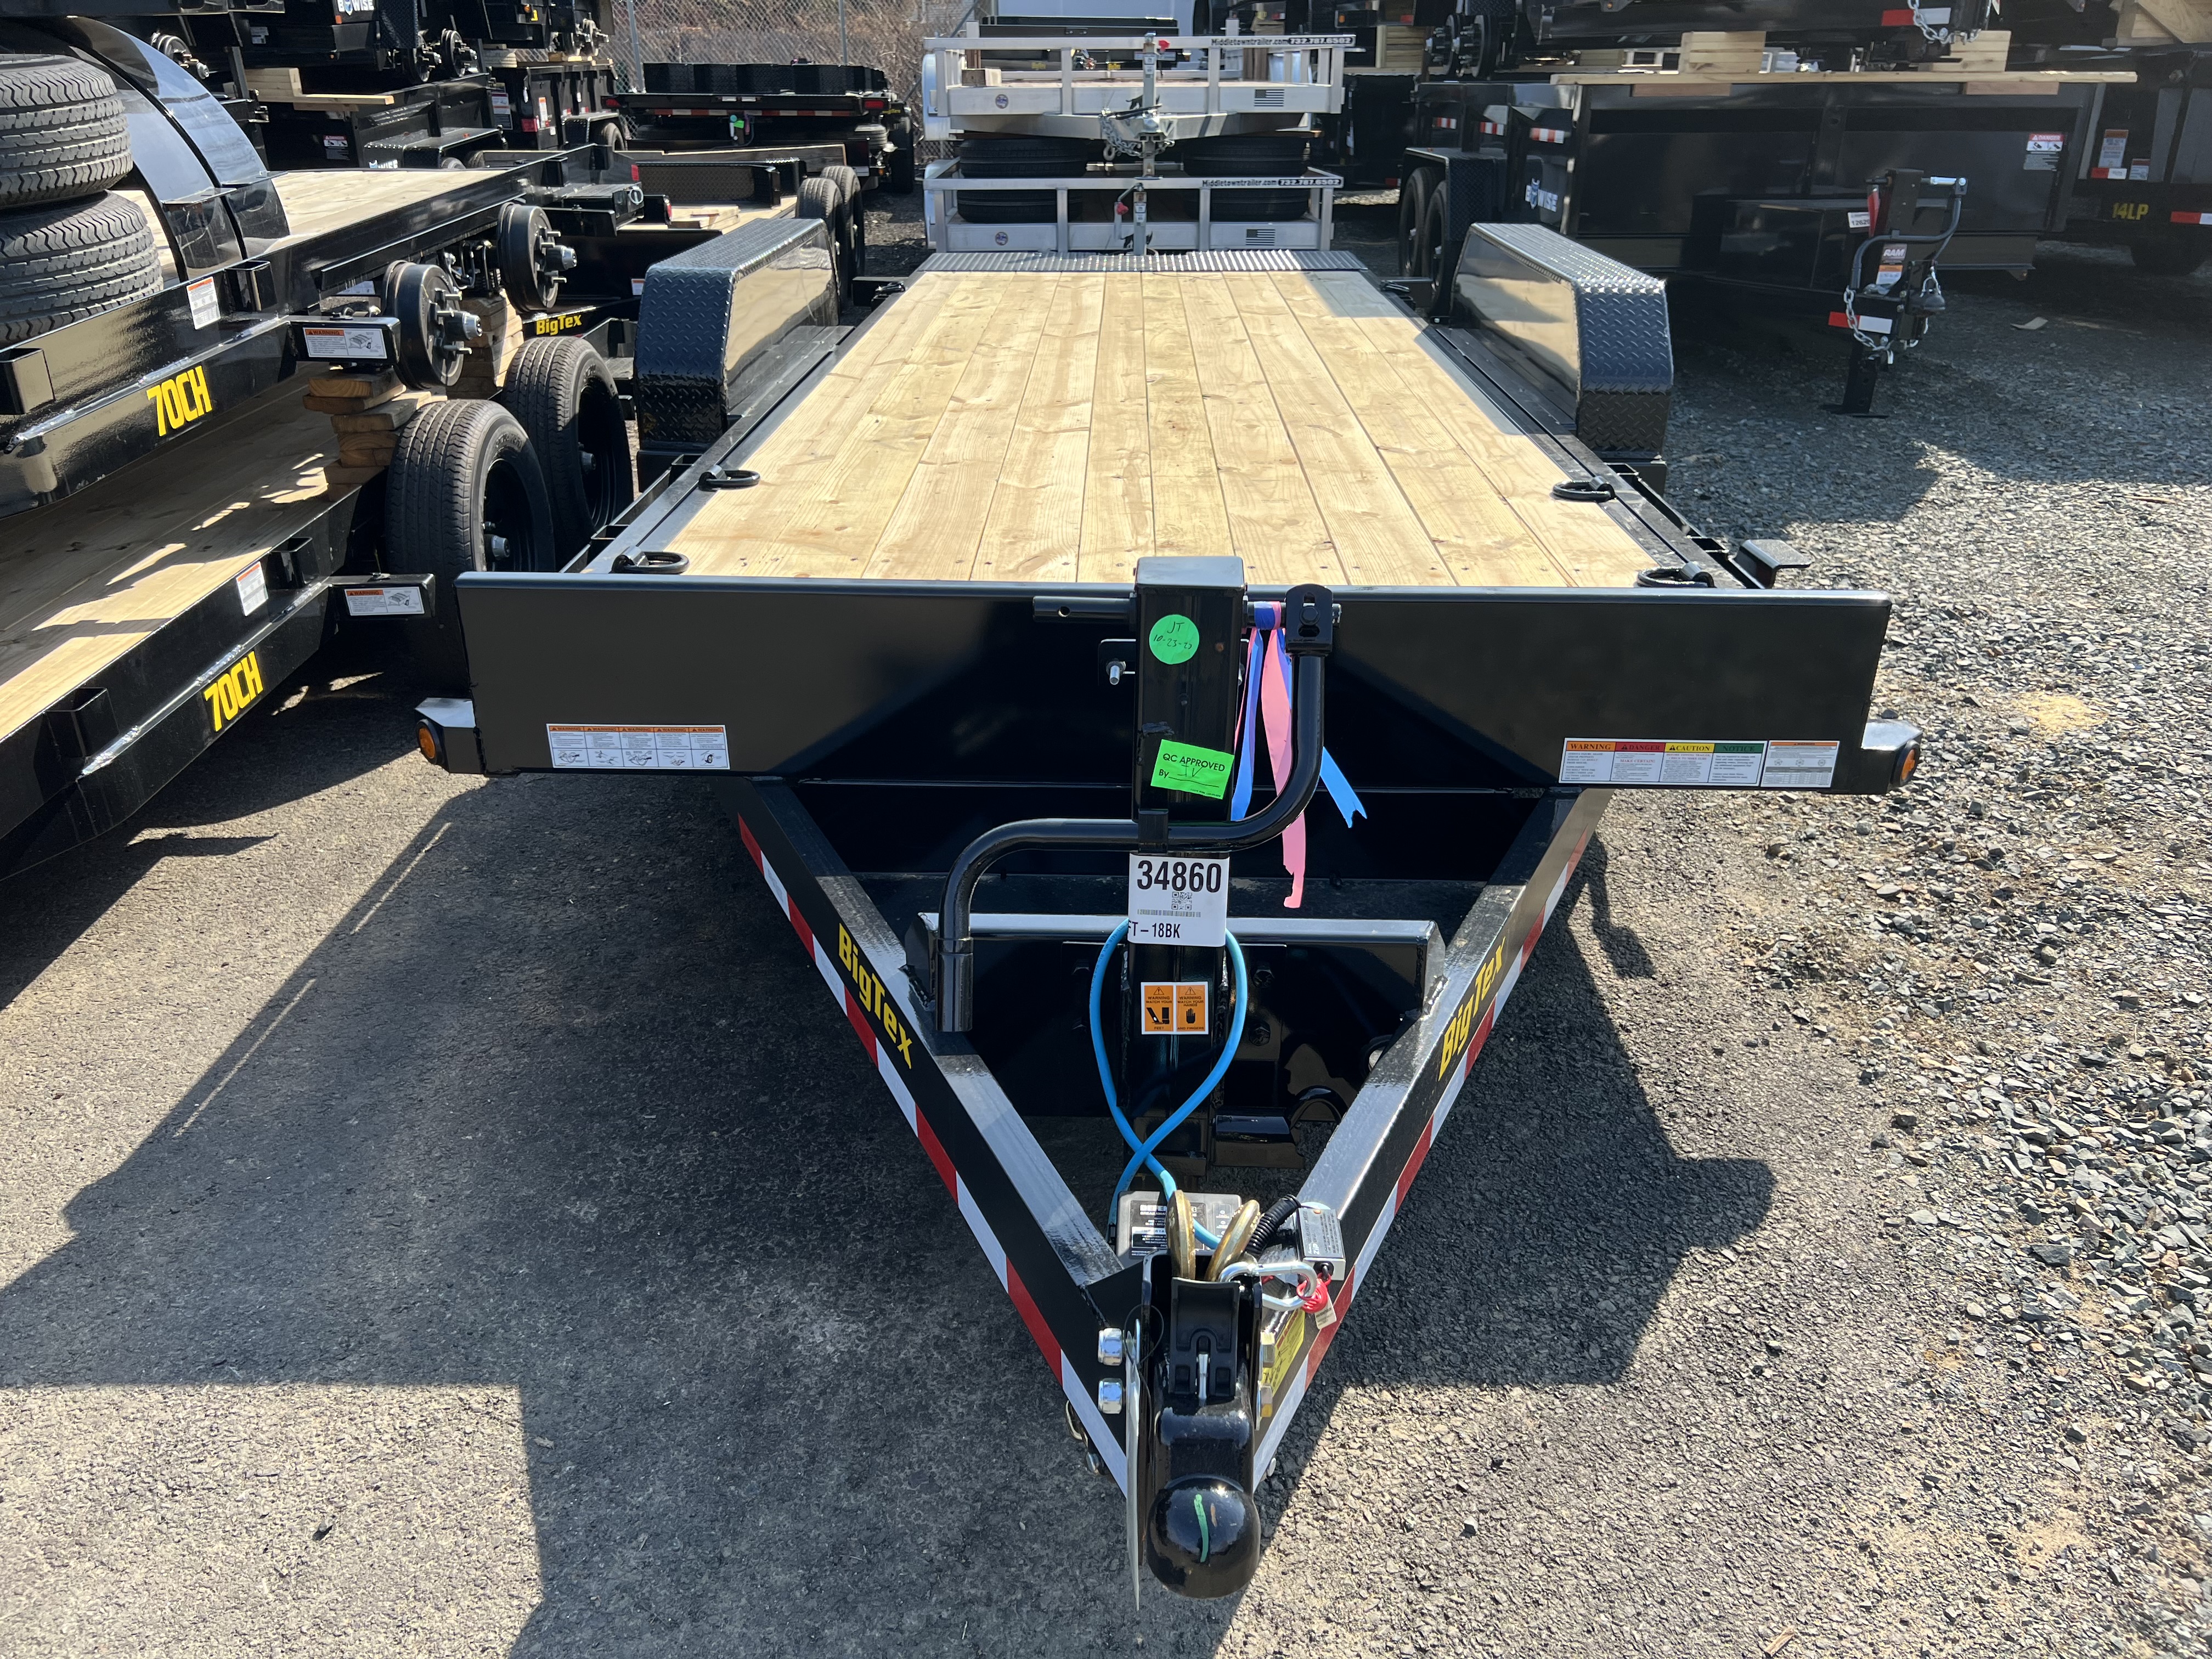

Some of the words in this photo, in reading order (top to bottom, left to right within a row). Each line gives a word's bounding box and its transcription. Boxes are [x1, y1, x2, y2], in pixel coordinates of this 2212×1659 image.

[2112, 202, 2149, 220] 14LP
[1883, 249, 1906, 257] RAM
[536, 314, 582, 336] BigTex
[146, 365, 213, 437] 70CH
[204, 651, 264, 732] 70CH
[1159, 769, 1169, 778] By
[1163, 753, 1178, 762] QC
[1180, 756, 1225, 772] APPROVED
[1137, 860, 1222, 893] 34860
[838, 923, 913, 1070] BigTex
[1438, 935, 1506, 1082] BigTex
